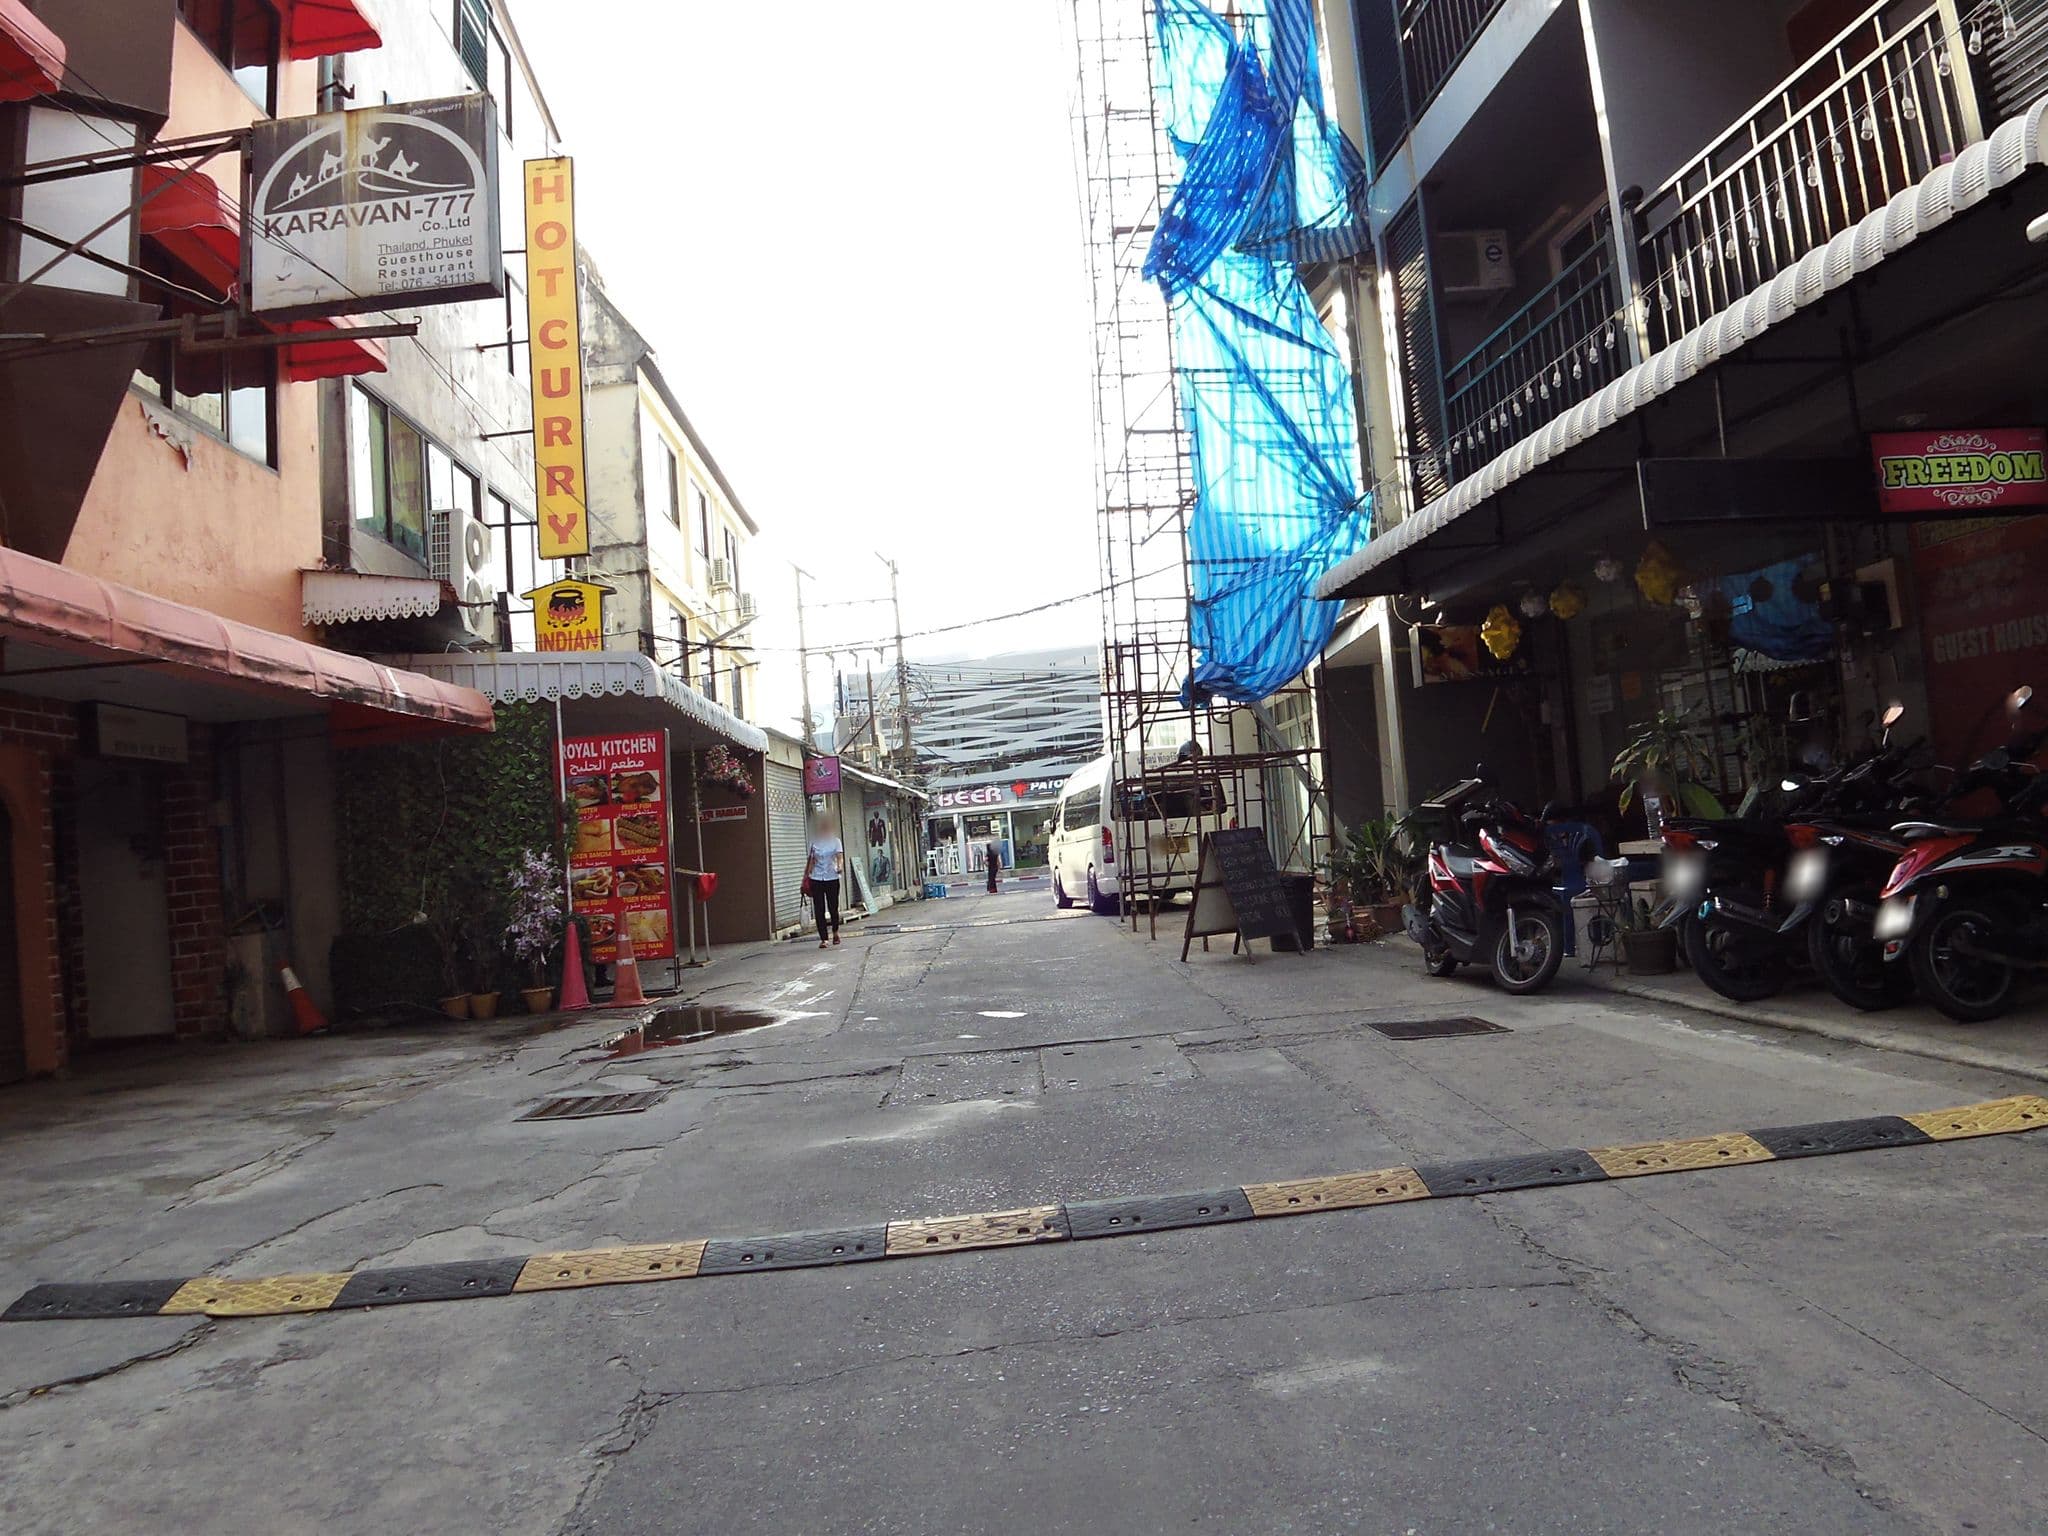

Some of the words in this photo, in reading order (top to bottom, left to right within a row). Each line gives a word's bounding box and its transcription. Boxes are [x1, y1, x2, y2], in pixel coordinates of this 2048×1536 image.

[264, 193, 475, 238] KARAVAN-777
[433, 235, 473, 249] Phuket
[532, 175, 567, 298] HOT
[378, 248, 473, 267] Guesthouse
[378, 260, 474, 279] Restaurant
[401, 277, 423, 290] 076
[434, 272, 476, 287] 341113
[539, 319, 578, 545] CURRY
[1881, 452, 2046, 488] FREEDOM
[538, 629, 599, 652] INDIAN
[1933, 626, 1989, 664] GUEST
[601, 737, 656, 757] KITCHEN
[610, 757, 645, 772] مطعم
[939, 786, 1002, 807] BEER
